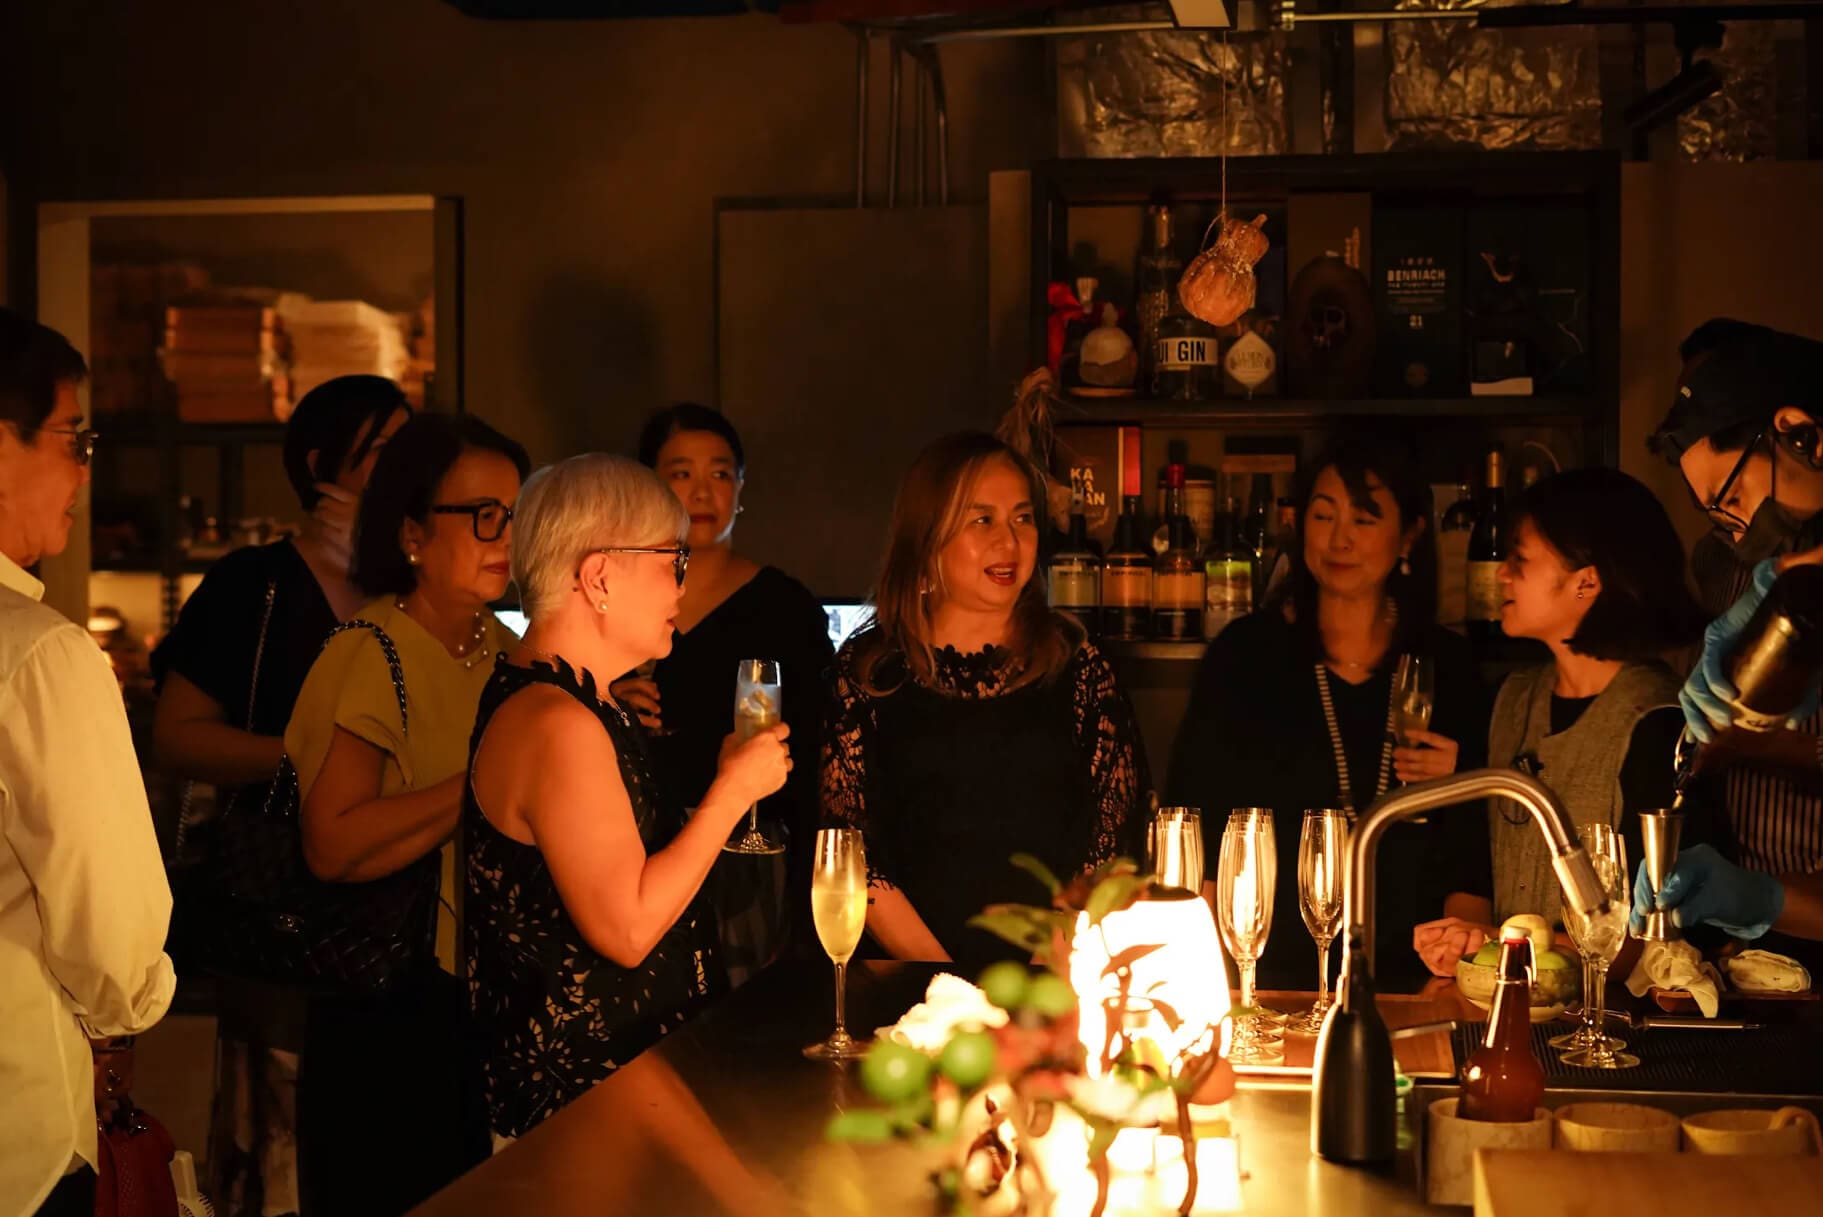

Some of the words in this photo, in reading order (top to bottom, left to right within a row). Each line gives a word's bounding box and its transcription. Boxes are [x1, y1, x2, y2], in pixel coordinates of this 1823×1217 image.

[1387, 268, 1446, 281] BENRIACH
[1177, 340, 1206, 362] GIN
[1069, 467, 1094, 481] KA
